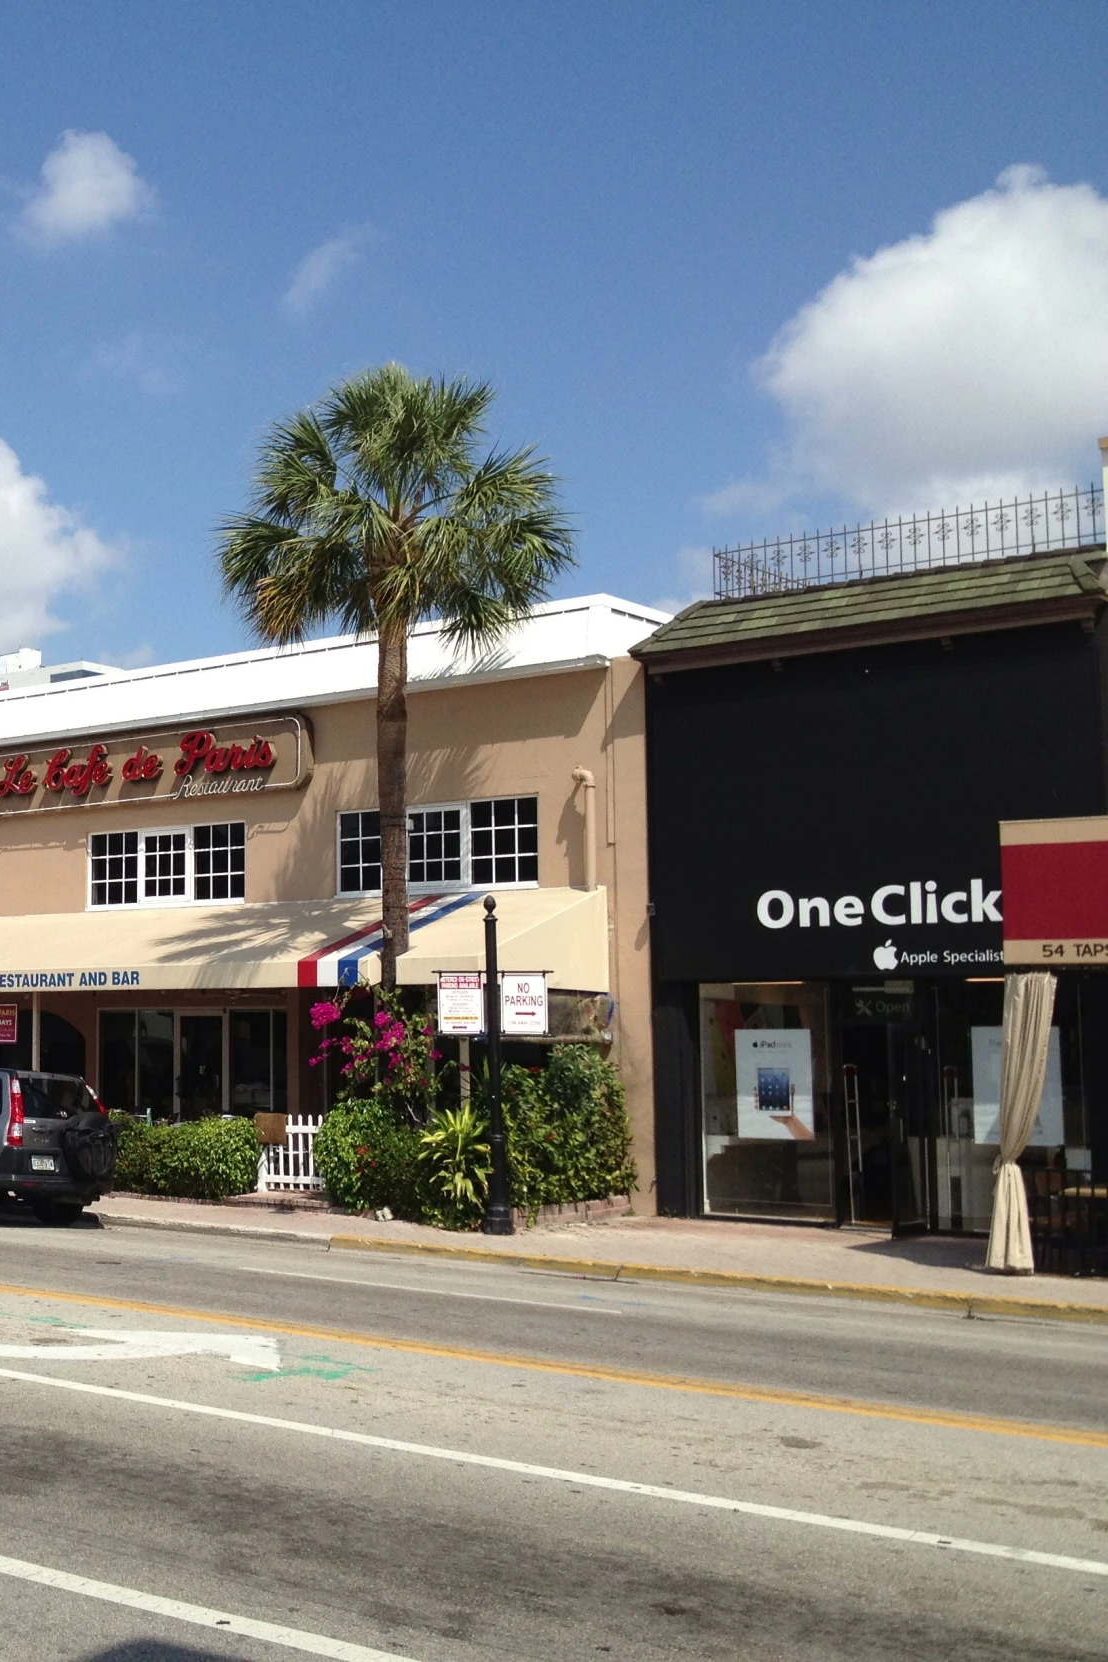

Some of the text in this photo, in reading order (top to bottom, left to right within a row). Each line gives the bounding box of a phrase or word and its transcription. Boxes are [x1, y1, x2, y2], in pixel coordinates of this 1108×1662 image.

[121, 746, 163, 781] de
[174, 730, 277, 777] Paris
[173, 775, 264, 799] Restaurant
[900, 949, 1004, 965] Apple Specialist
[1042, 944, 1065, 958] 54
[79, 971, 107, 986] AND
[112, 970, 140, 985] BAR
[517, 982, 530, 994] NO
[504, 995, 544, 1007] PARKING
[875, 1001, 910, 1014] Open
[760, 1040, 776, 1048] iPad
